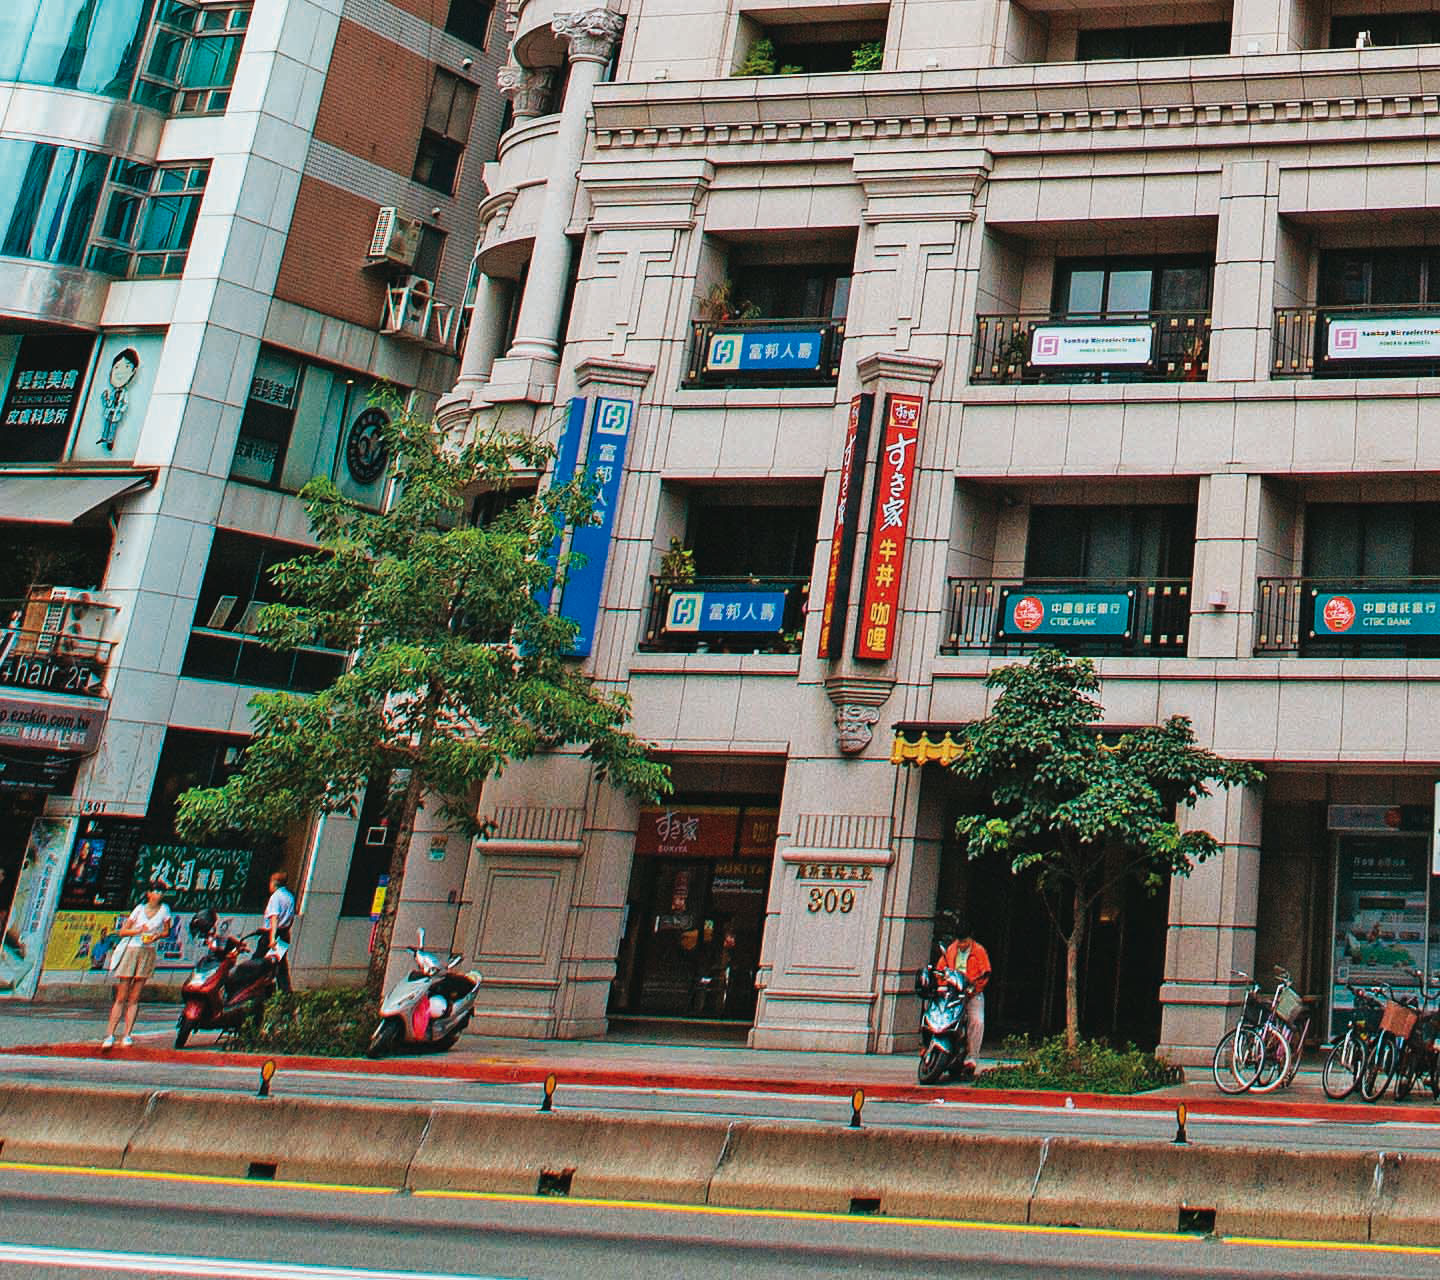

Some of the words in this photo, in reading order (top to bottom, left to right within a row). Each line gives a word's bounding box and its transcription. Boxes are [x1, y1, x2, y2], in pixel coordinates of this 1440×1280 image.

[748, 341, 815, 361] 富邦人壽
[879, 432, 918, 532] すき家
[708, 602, 777, 622] 富邦人壽
[1050, 601, 1121, 617] 中國信託銀行
[1362, 600, 1437, 616] 中國信託銀行
[64, 666, 90, 691] 2F
[807, 887, 858, 915] 309
